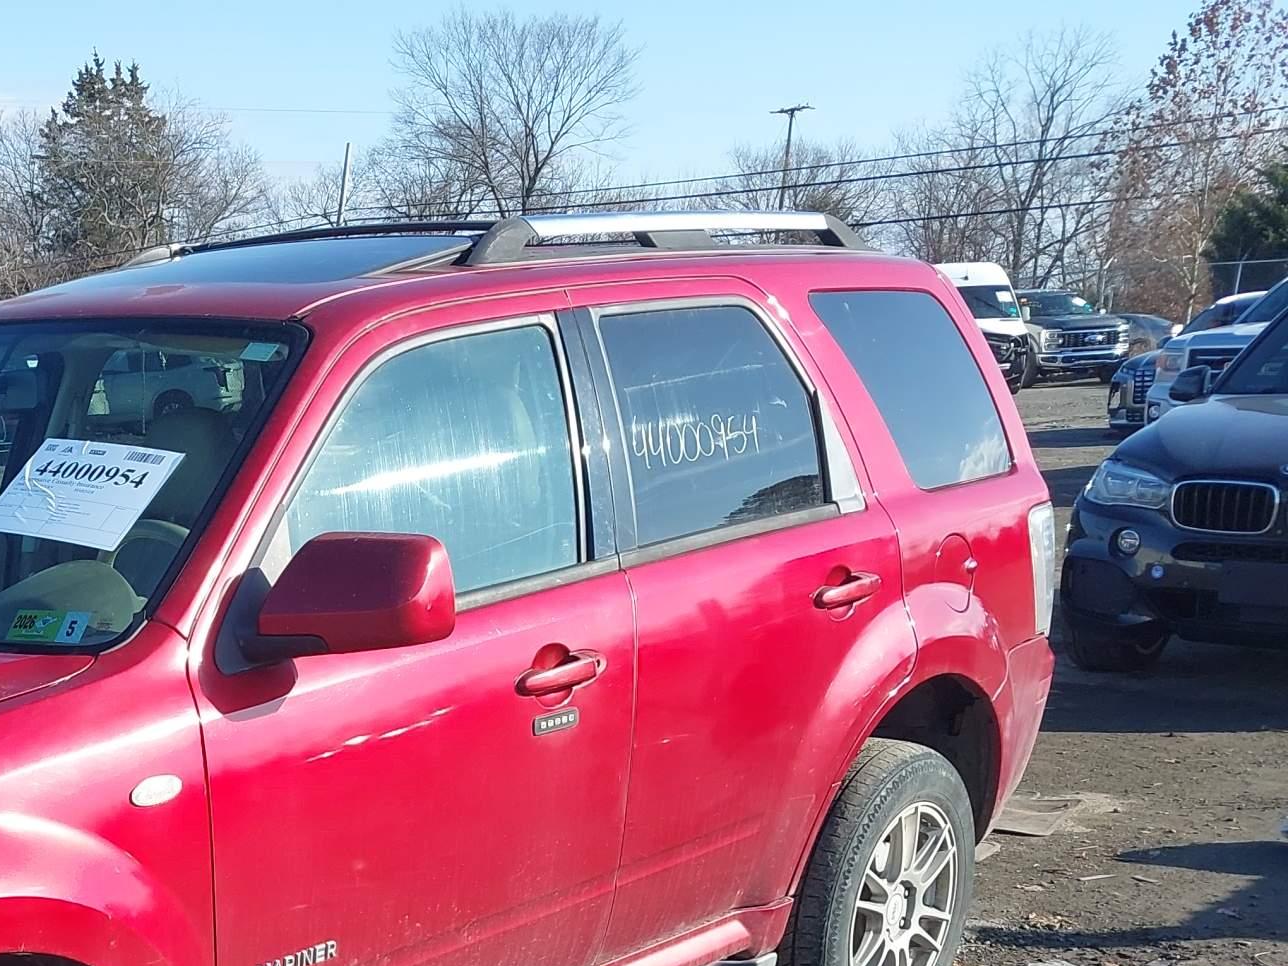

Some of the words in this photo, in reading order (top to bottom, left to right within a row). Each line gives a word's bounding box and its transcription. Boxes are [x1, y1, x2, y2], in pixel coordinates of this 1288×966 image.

[632, 414, 759, 469] 44000954
[35, 459, 150, 489] 44000954
[13, 614, 37, 629] 2026
[65, 620, 78, 637] 5
